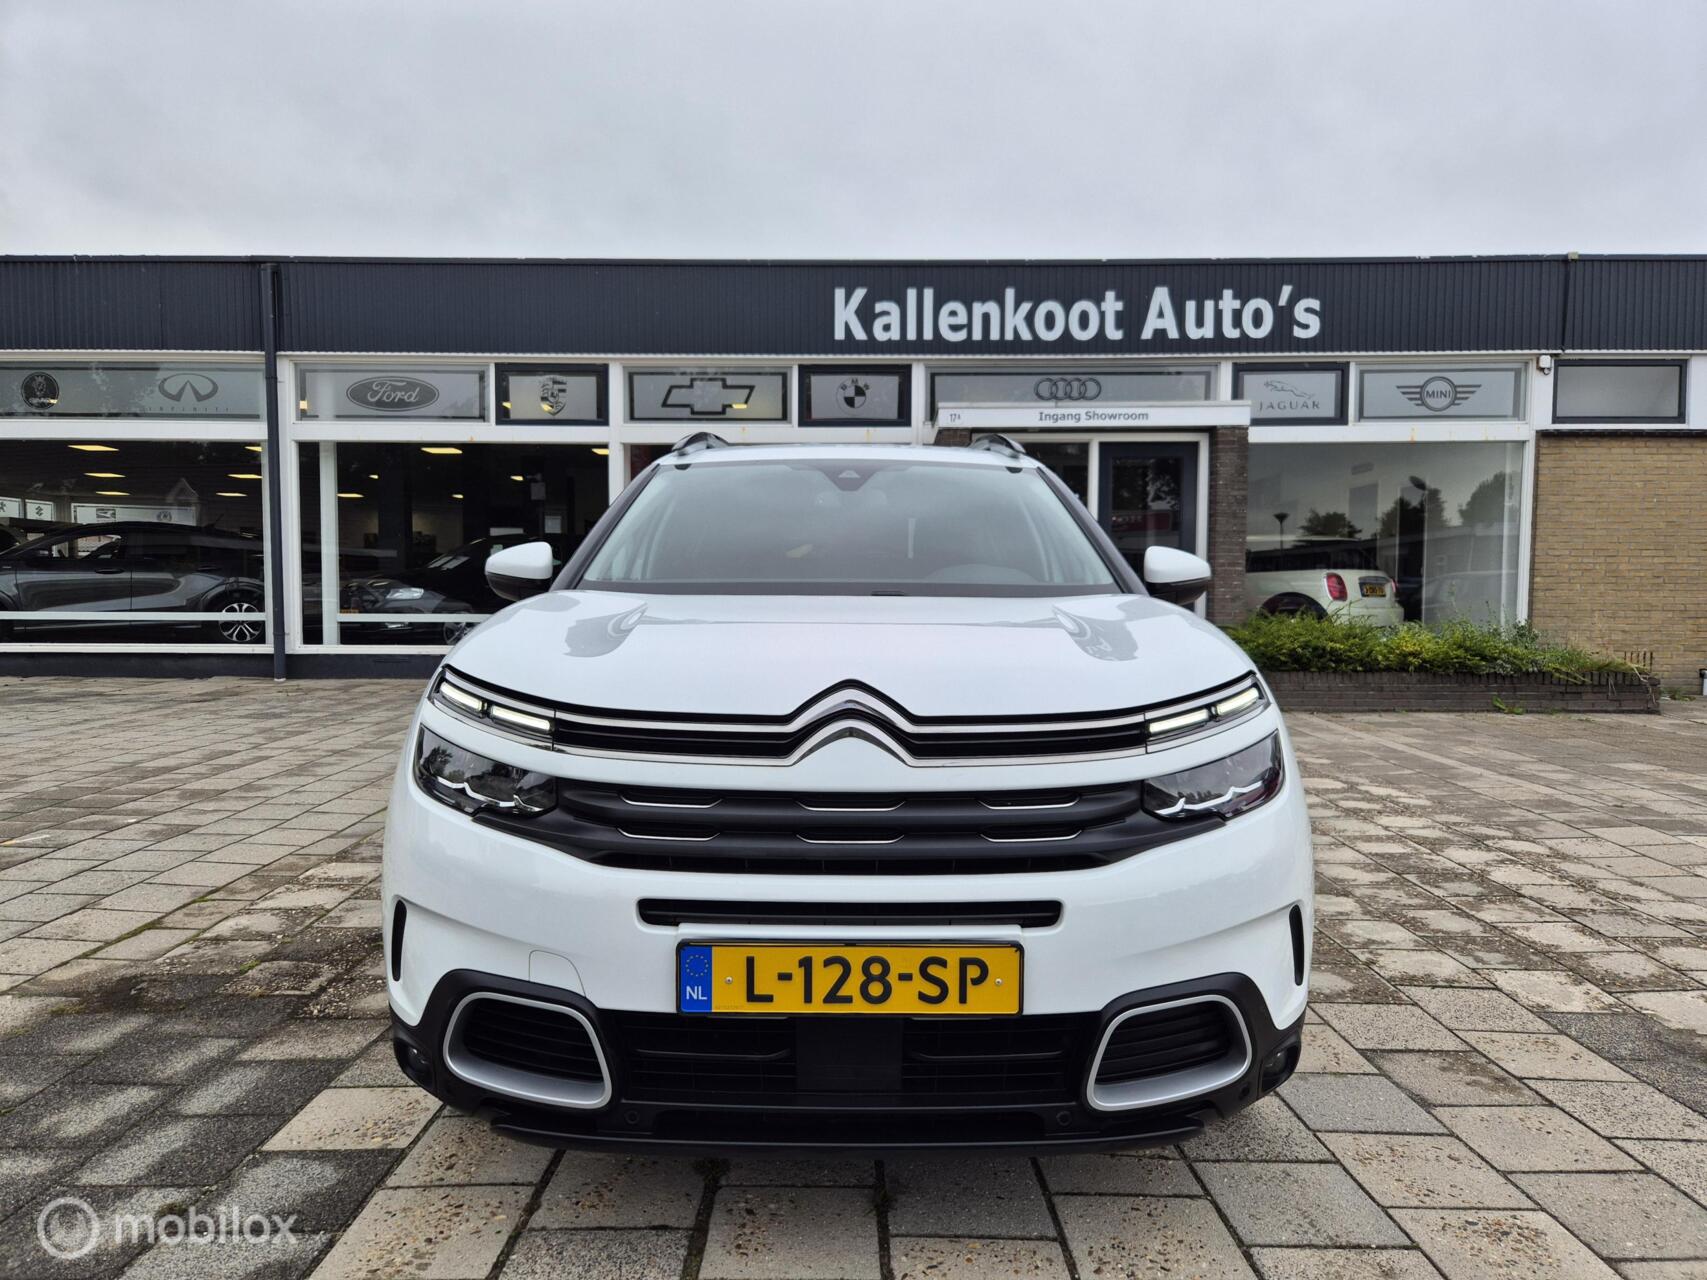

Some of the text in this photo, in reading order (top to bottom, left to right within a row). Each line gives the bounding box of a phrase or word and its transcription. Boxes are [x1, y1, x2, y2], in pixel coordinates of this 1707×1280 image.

[833, 285, 1322, 342] Kallenkoot Auto's
[367, 380, 420, 402] Ford
[1425, 389, 1451, 399] MINI
[1259, 400, 1320, 411] JAGUAR
[1038, 410, 1150, 423] Ingang Showroom
[745, 956, 990, 1005] L-128-SP
[686, 985, 707, 1000] NL
